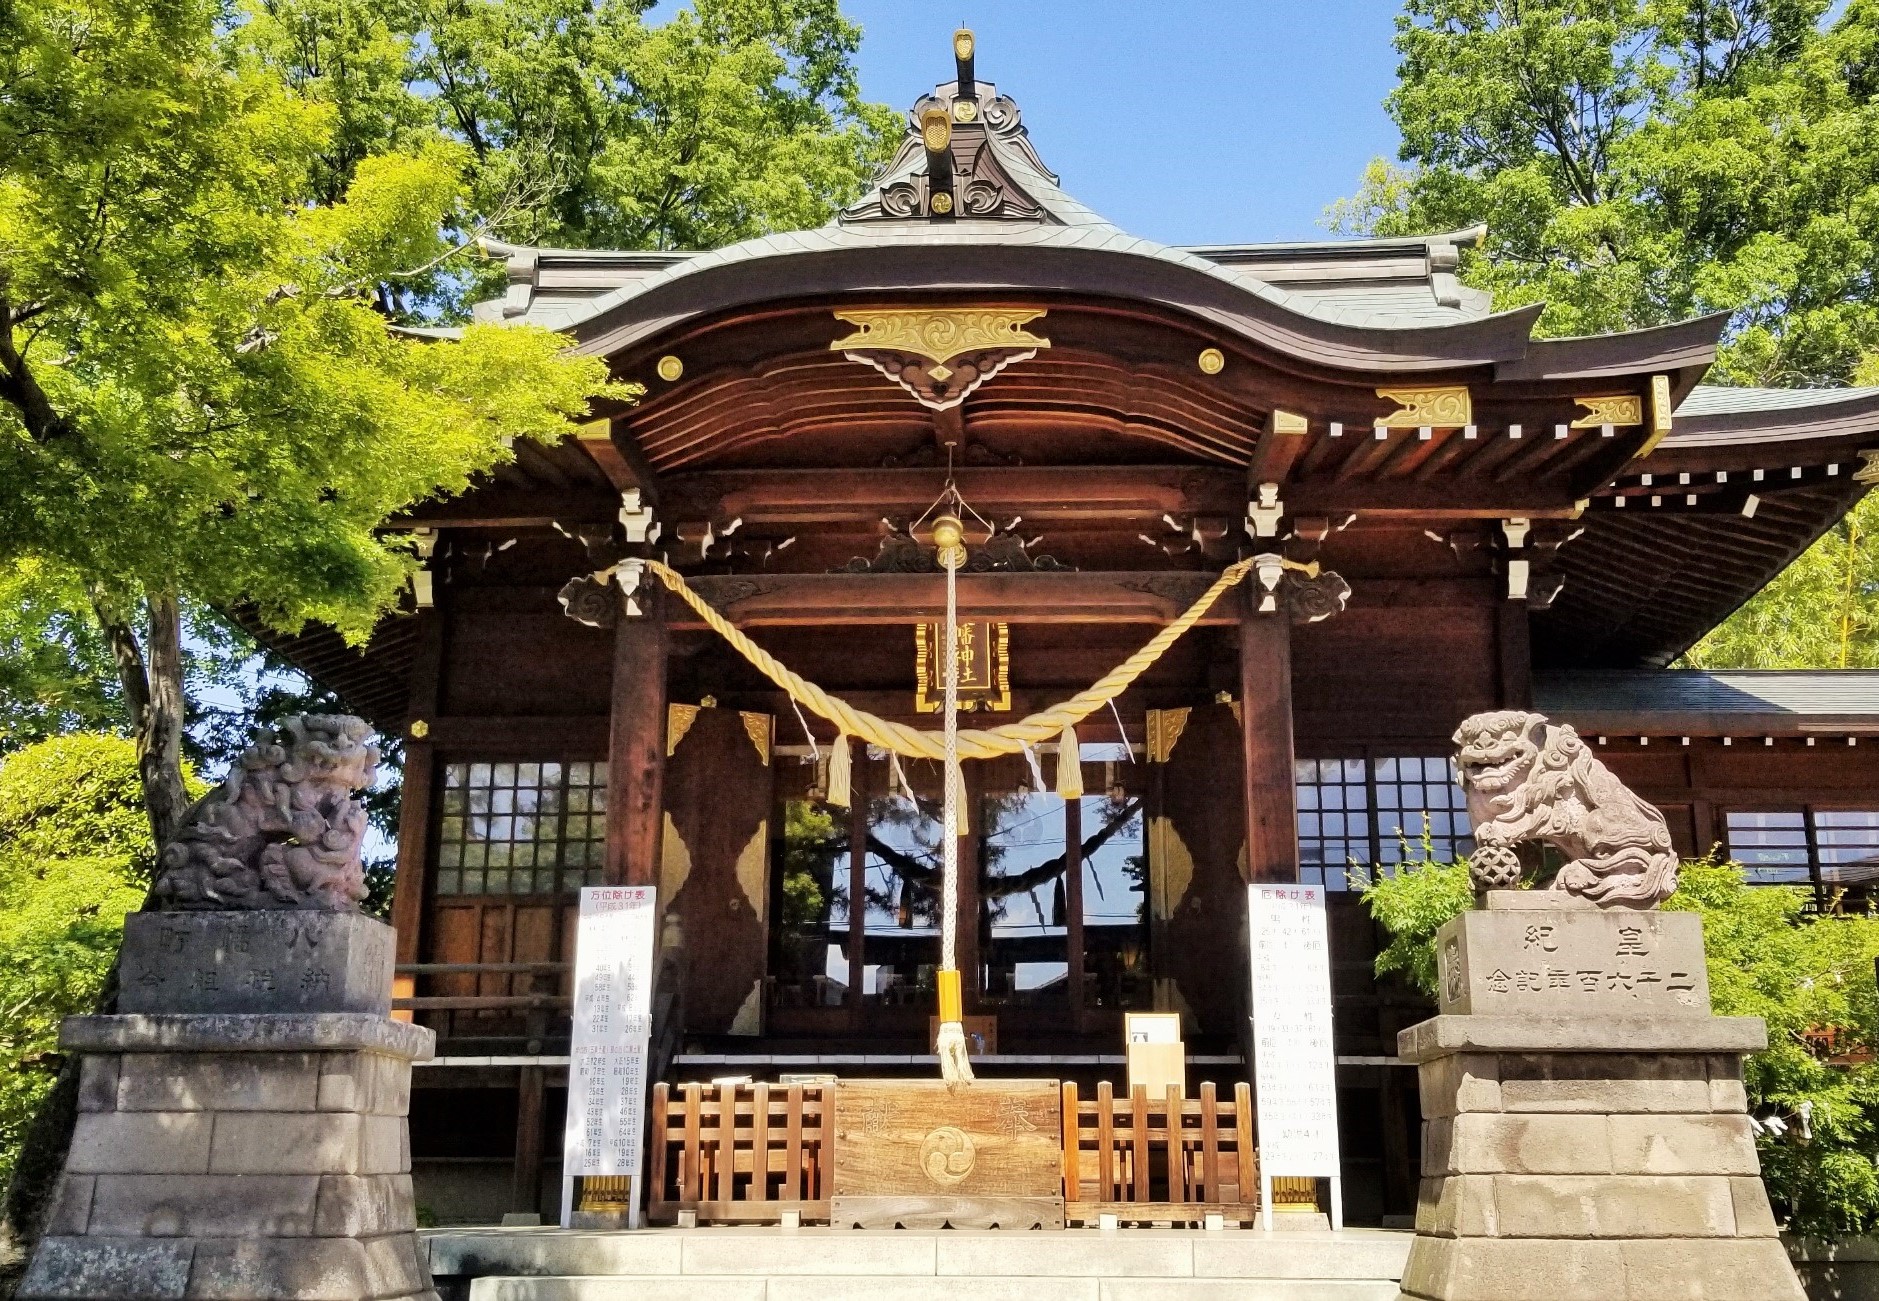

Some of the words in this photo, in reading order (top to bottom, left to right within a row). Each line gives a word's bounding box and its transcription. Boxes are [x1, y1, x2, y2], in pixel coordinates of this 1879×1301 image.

[590, 890, 646, 901] 方位除け表
[1261, 889, 1316, 900] 厄除け表
[595, 901, 642, 911] (平成31年)
